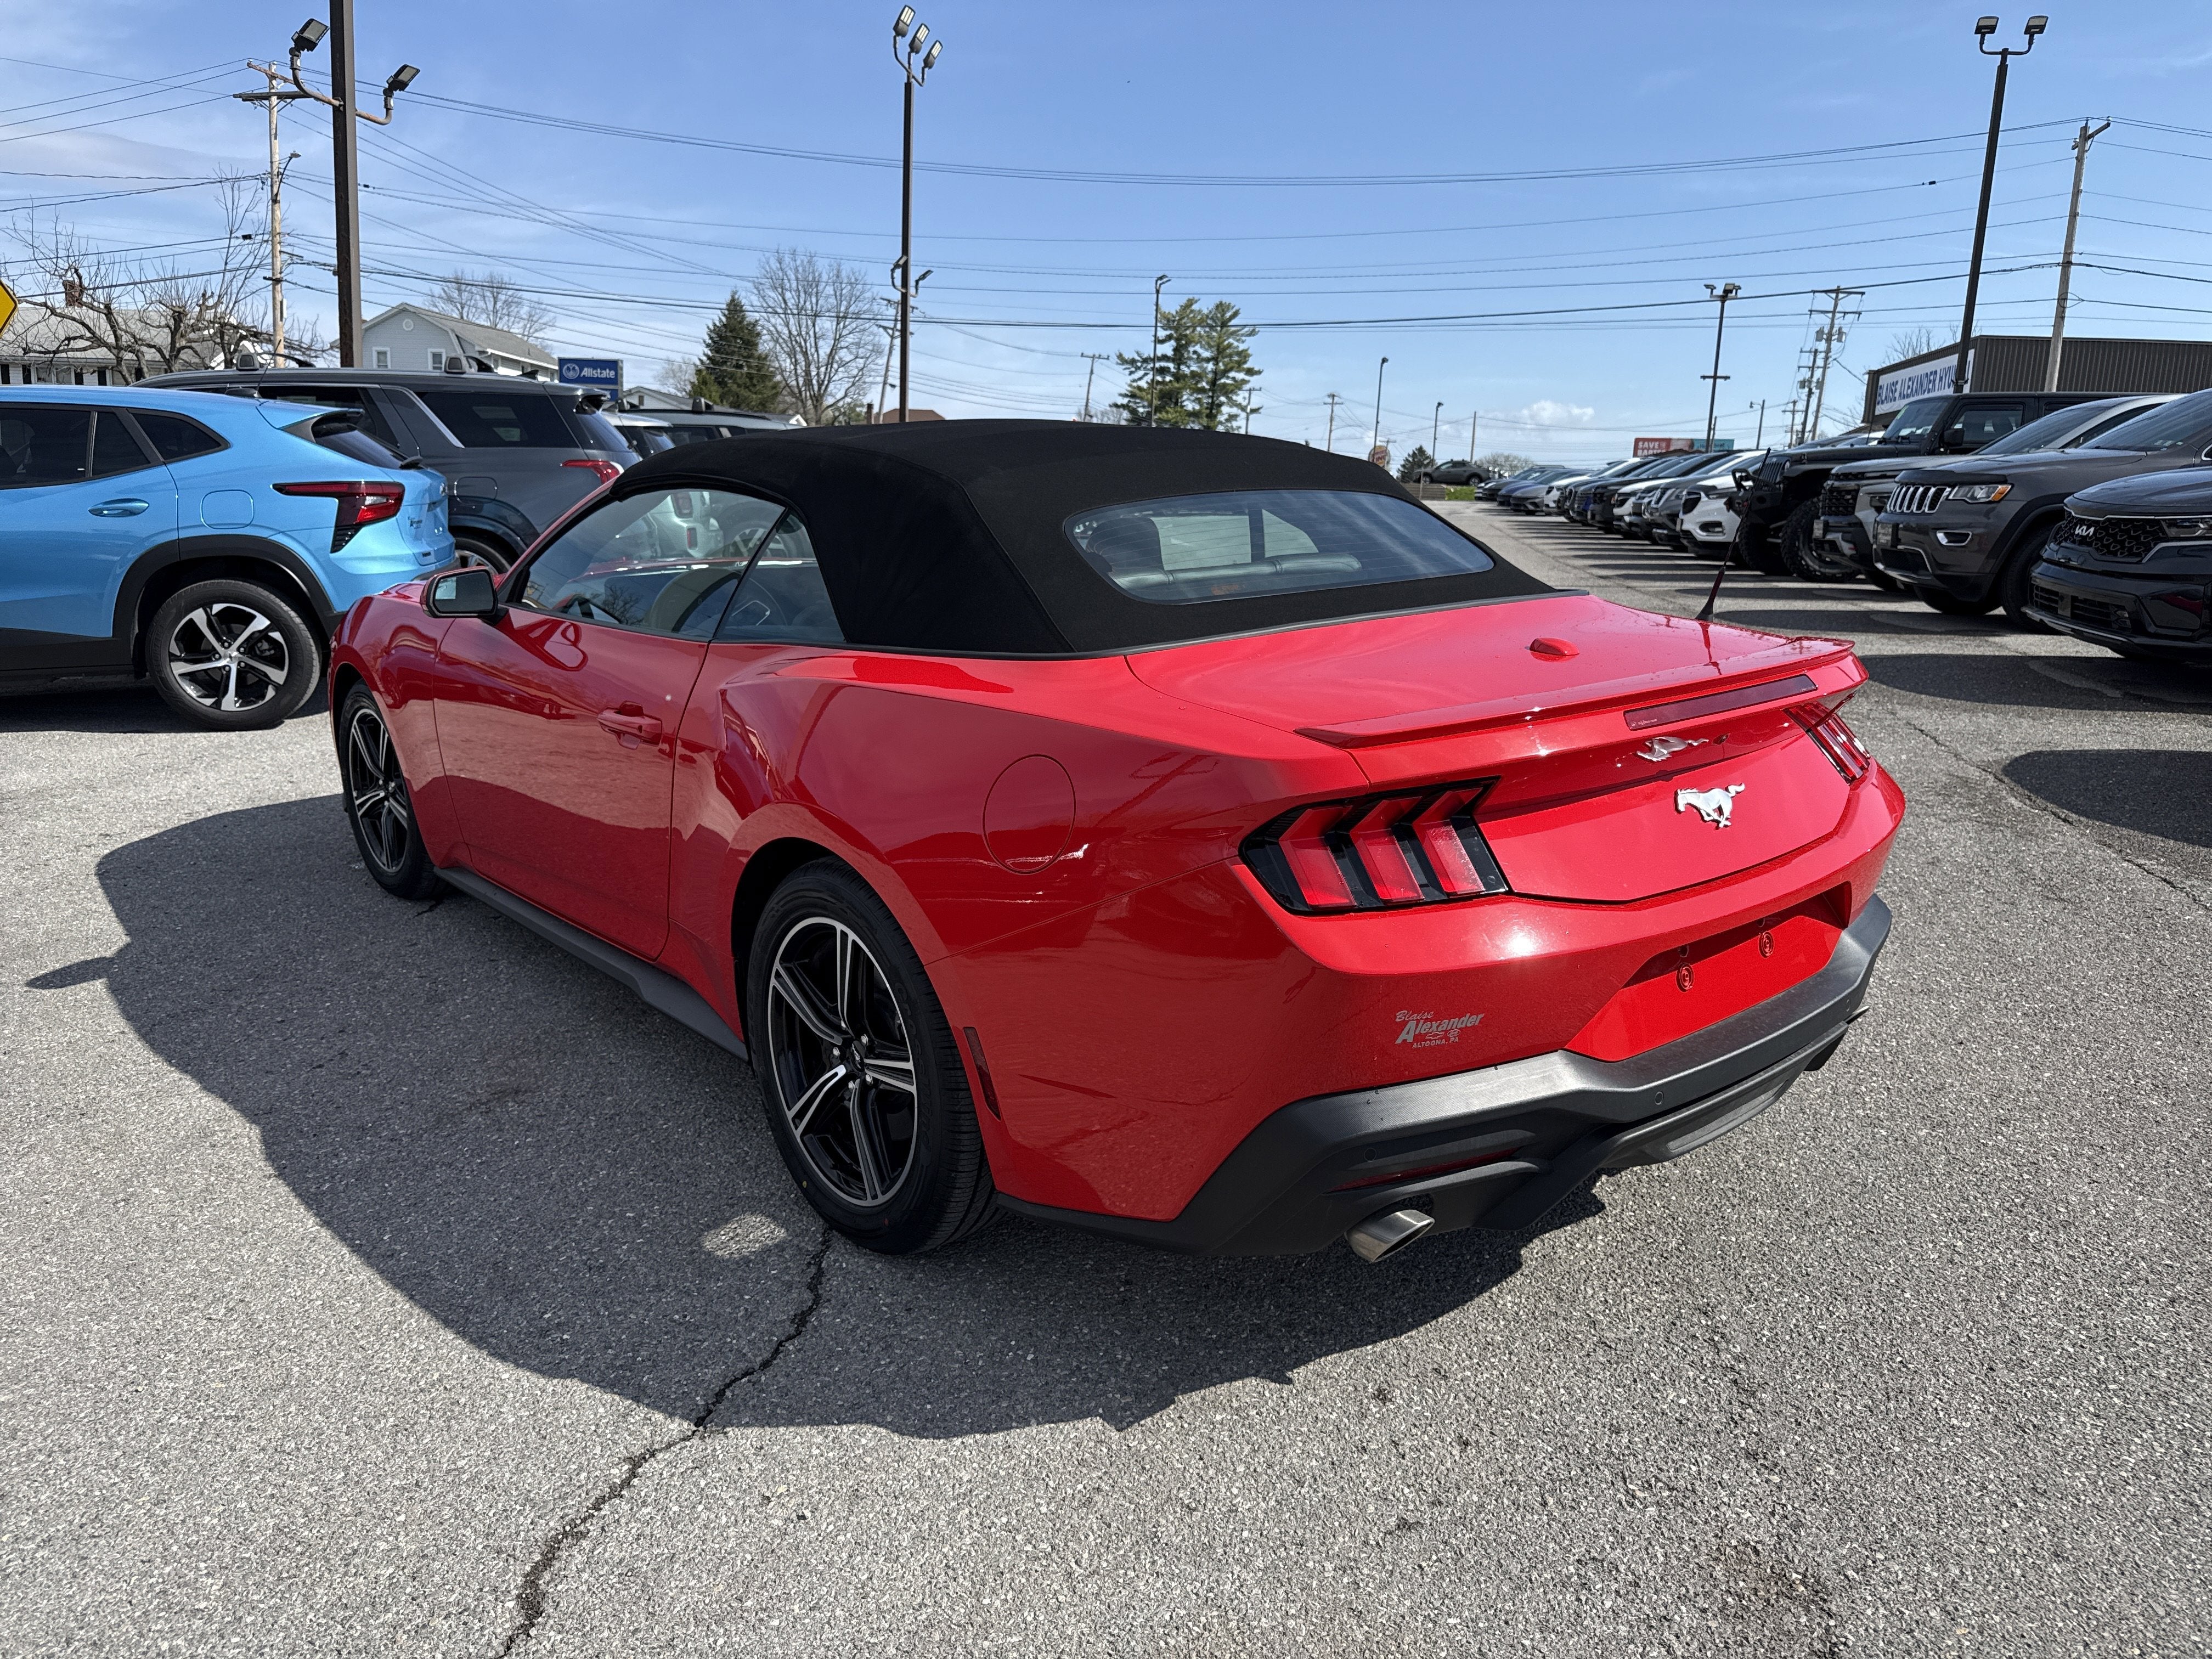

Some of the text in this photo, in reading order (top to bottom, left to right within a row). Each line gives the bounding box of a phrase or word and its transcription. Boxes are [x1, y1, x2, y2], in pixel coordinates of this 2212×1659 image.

[580, 368, 615, 378] Allstate
[1877, 360, 1971, 405] BLAISE ALEXANDER HYUI
[1638, 441, 1660, 449] SAVE
[1395, 1010, 1435, 1022] Blaise
[1395, 1014, 1485, 1044] Alexander
